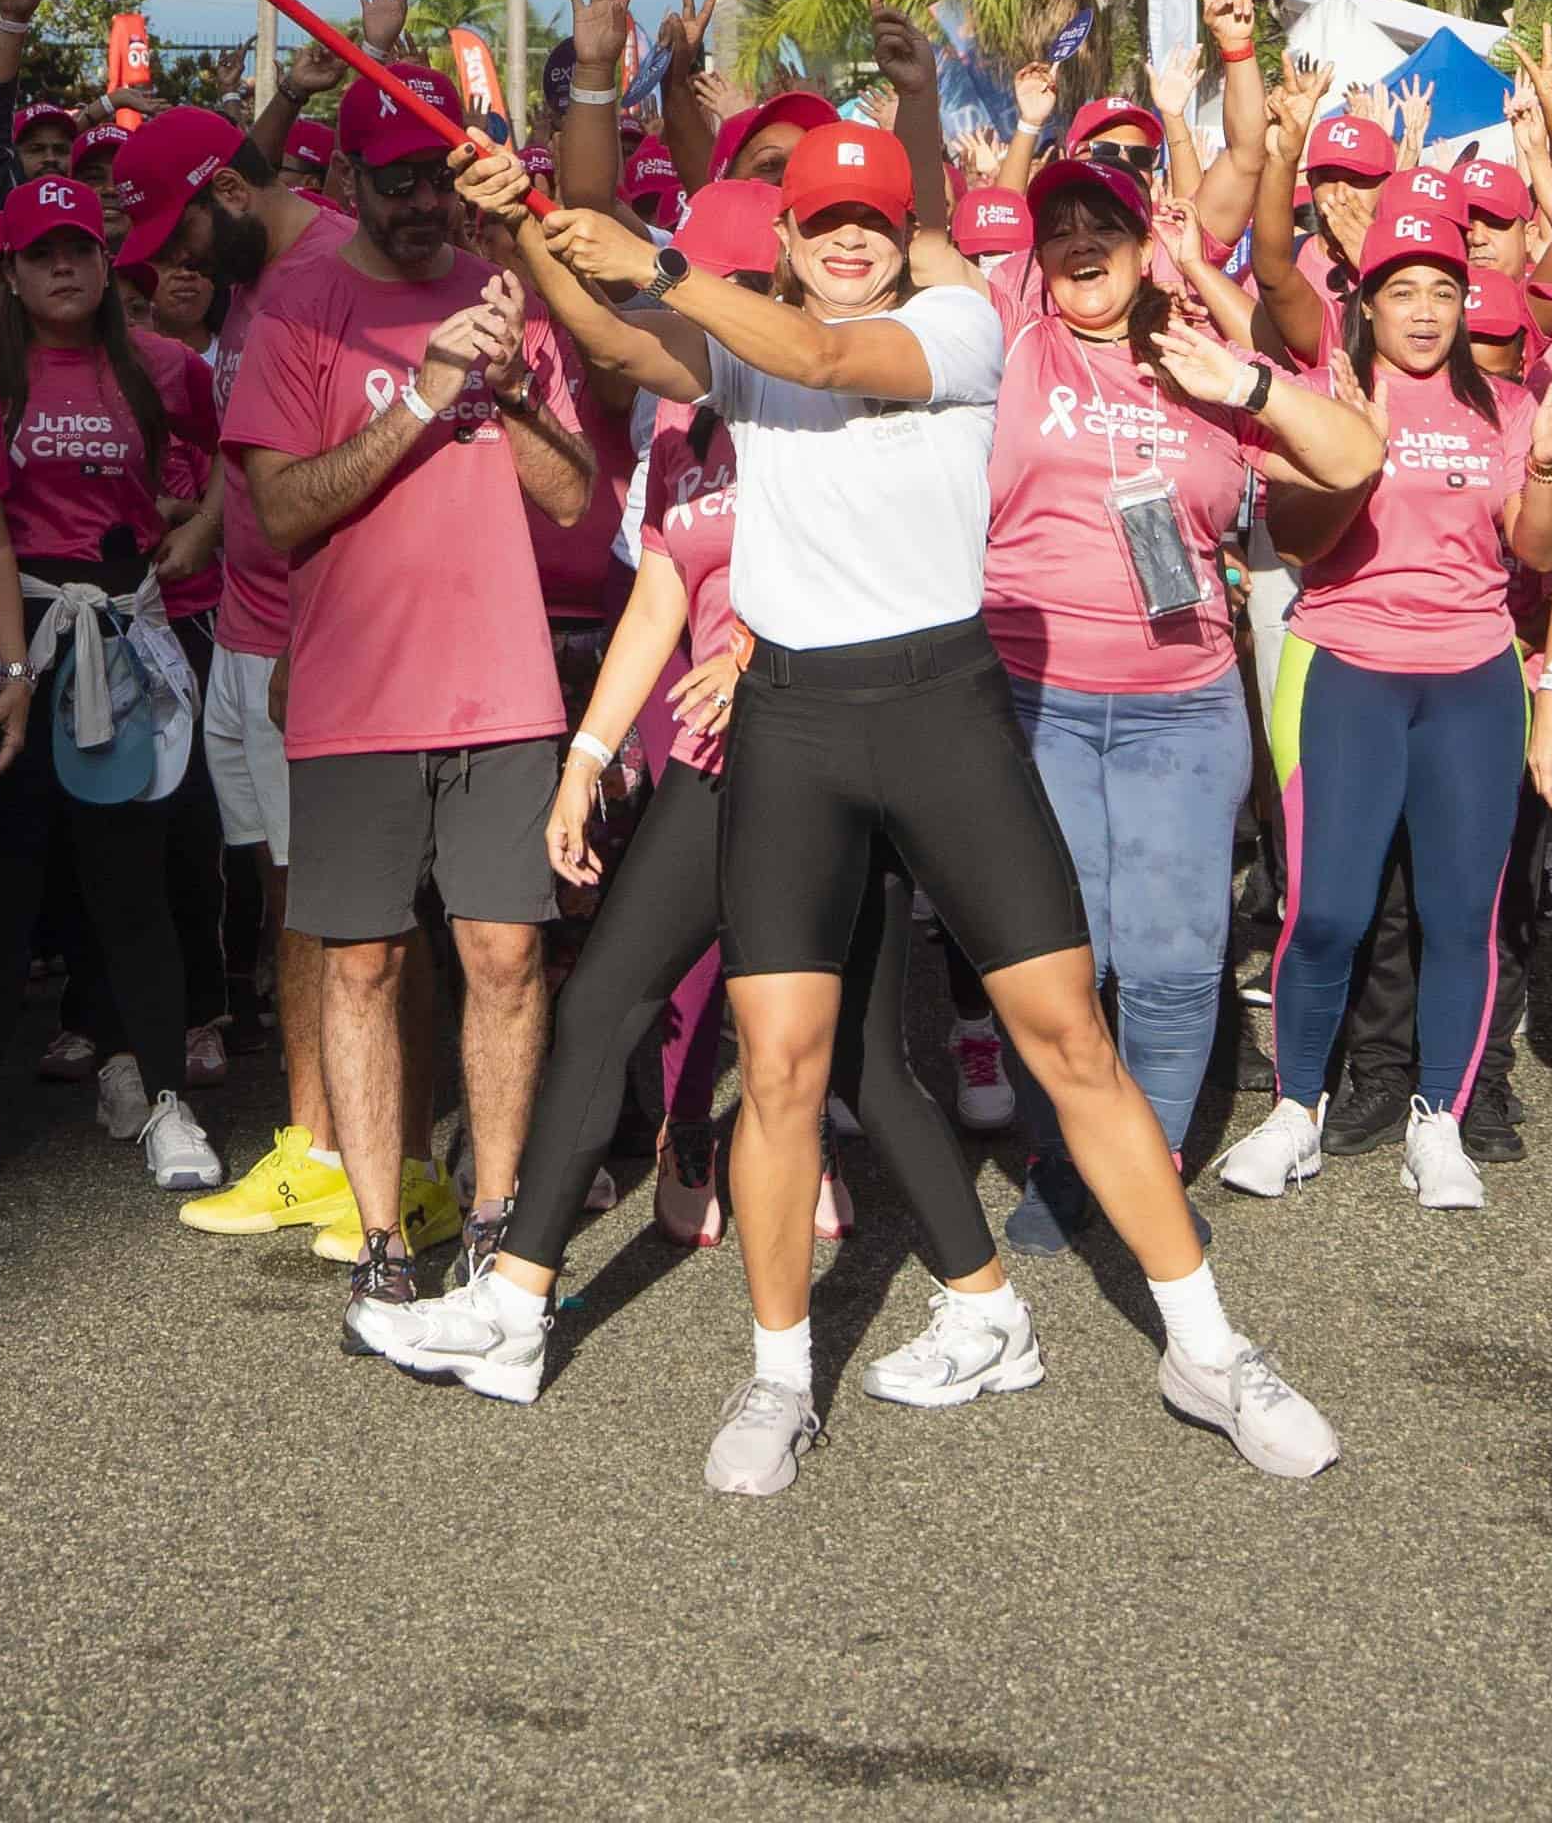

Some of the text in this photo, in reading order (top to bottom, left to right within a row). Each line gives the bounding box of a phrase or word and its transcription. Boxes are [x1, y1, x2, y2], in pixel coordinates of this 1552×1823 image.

[1328, 121, 1360, 148] GC
[1411, 172, 1448, 201] GC
[1463, 162, 1495, 188] GC
[39, 181, 76, 210] GC
[1394, 214, 1432, 242] GC
[28, 412, 113, 435] Juntos
[438, 399, 500, 423] ecer
[31, 437, 129, 460] Crecer
[1394, 428, 1470, 451] Juntos
[1400, 449, 1490, 471] Crecer
